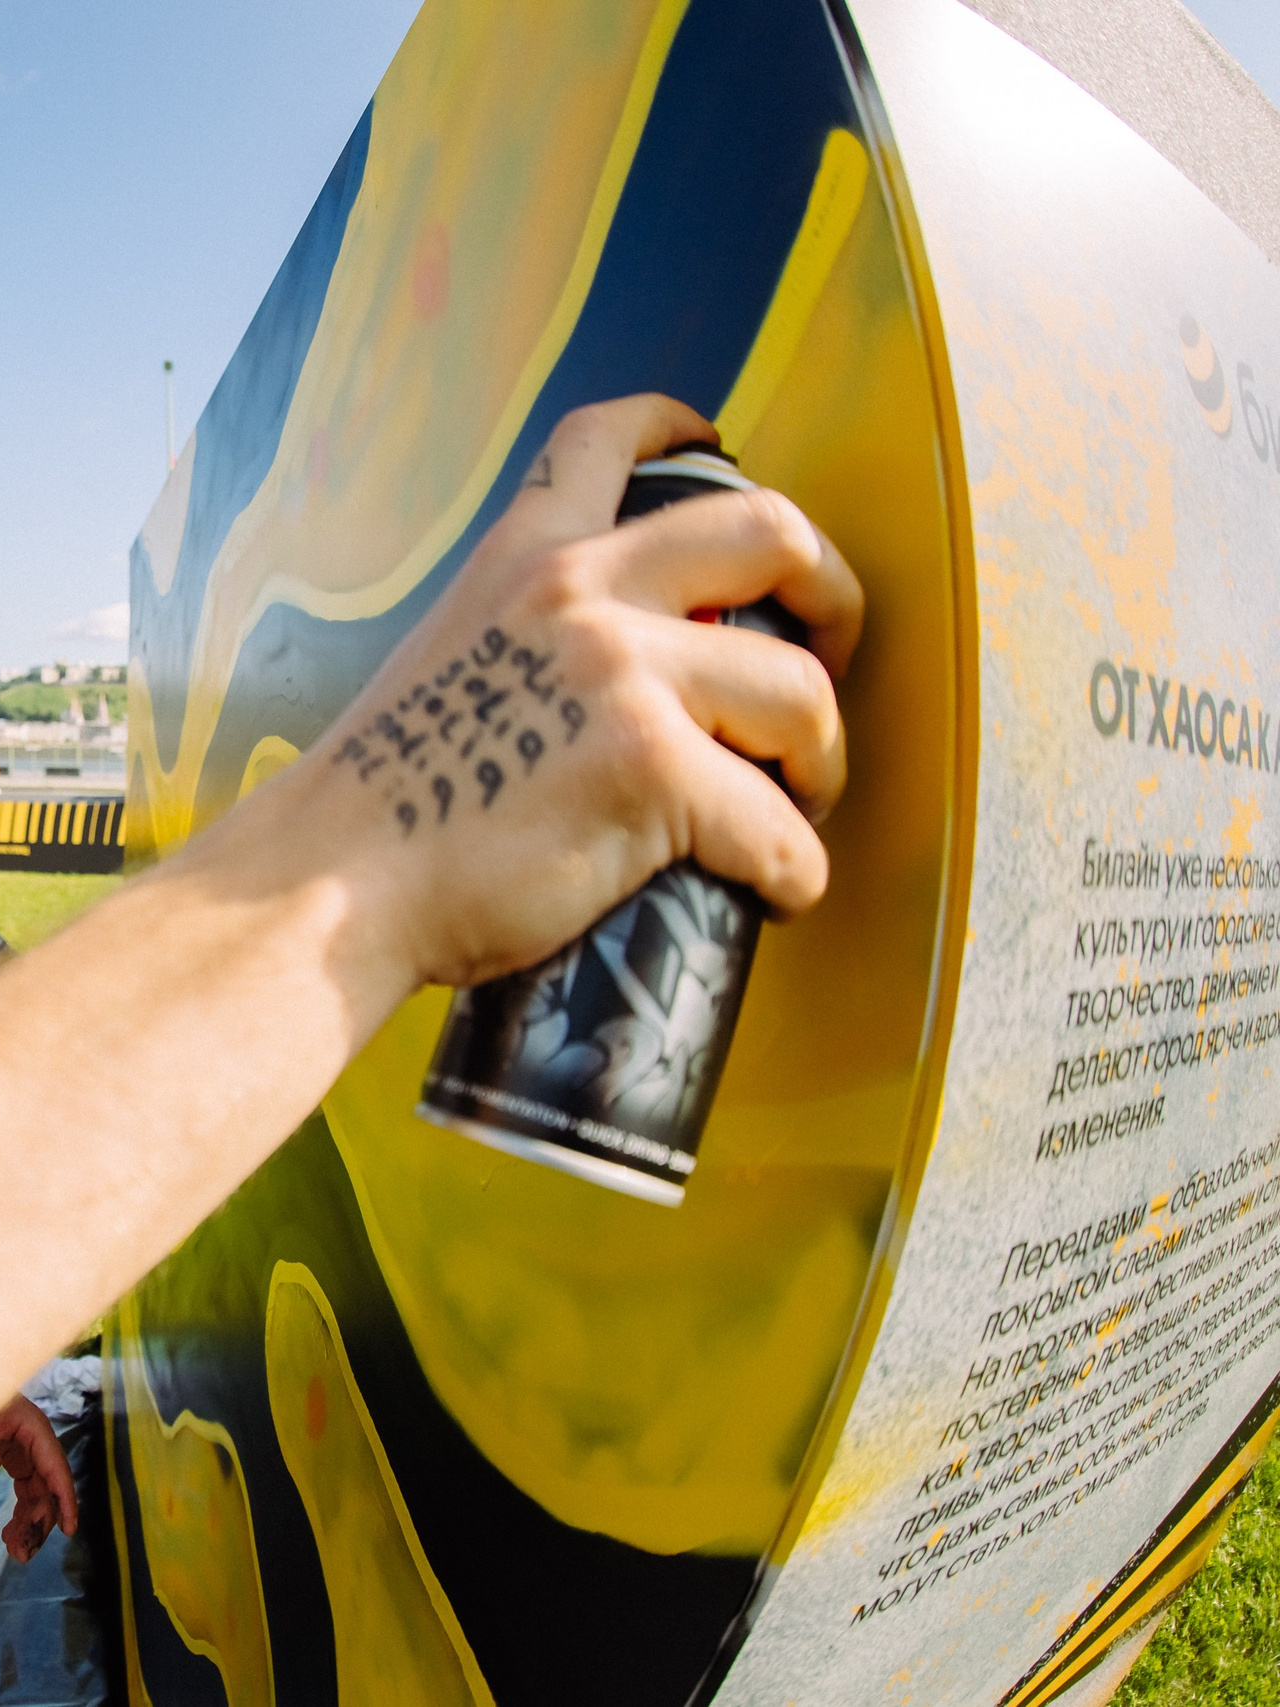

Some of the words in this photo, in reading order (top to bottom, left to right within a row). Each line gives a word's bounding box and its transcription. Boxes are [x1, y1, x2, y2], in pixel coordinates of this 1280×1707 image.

[1090, 659, 1140, 743] ОТ
[1147, 675, 1253, 769] ХАОСА
[1257, 710, 1270, 773] К
[1082, 838, 1161, 888] Билайн
[1165, 852, 1203, 899] уже
[1205, 855, 1280, 889] несколько
[1067, 977, 1195, 1032] творчество,
[1197, 965, 1270, 1008] движение
[1074, 917, 1179, 971] культуру
[1180, 917, 1192, 949] и
[1194, 911, 1275, 959] городские
[1035, 1096, 1165, 1163] изменения.
[1047, 1045, 1144, 1107] делают
[1144, 1028, 1204, 1078] город
[1204, 1020, 1243, 1065] ярче
[1243, 1017, 1254, 1048] и
[981, 1256, 1112, 1344] покрытой
[1112, 1223, 1192, 1285] следами
[1192, 1188, 1255, 1247] времени
[999, 1225, 1092, 1288] Перед
[1093, 1202, 1147, 1250] вами
[1171, 1169, 1222, 1214] образ
[939, 1354, 1096, 1449] постепенно
[1096, 1292, 1201, 1374] превращать
[1203, 1277, 1224, 1307] ее
[960, 1356, 1001, 1398] На
[1002, 1288, 1145, 1381] протяжении
[1145, 1241, 1228, 1313] фестиваля
[1225, 1208, 1280, 1262] художни
[879, 1545, 928, 1582] что
[924, 1507, 1001, 1565] даже
[1003, 1463, 1078, 1519] самые
[1080, 1407, 1162, 1474] обычные
[1160, 1352, 1237, 1423] городские
[895, 1450, 1048, 1544] привычное
[1182, 1346, 1212, 1380] Это
[916, 1455, 970, 1499] как
[974, 1381, 1111, 1471] творчество
[1113, 1326, 1198, 1396] способно
[850, 1565, 947, 1627] могут
[946, 1531, 1010, 1579] стать
[1011, 1471, 1106, 1544] холстом
[1100, 1450, 1138, 1492] для
